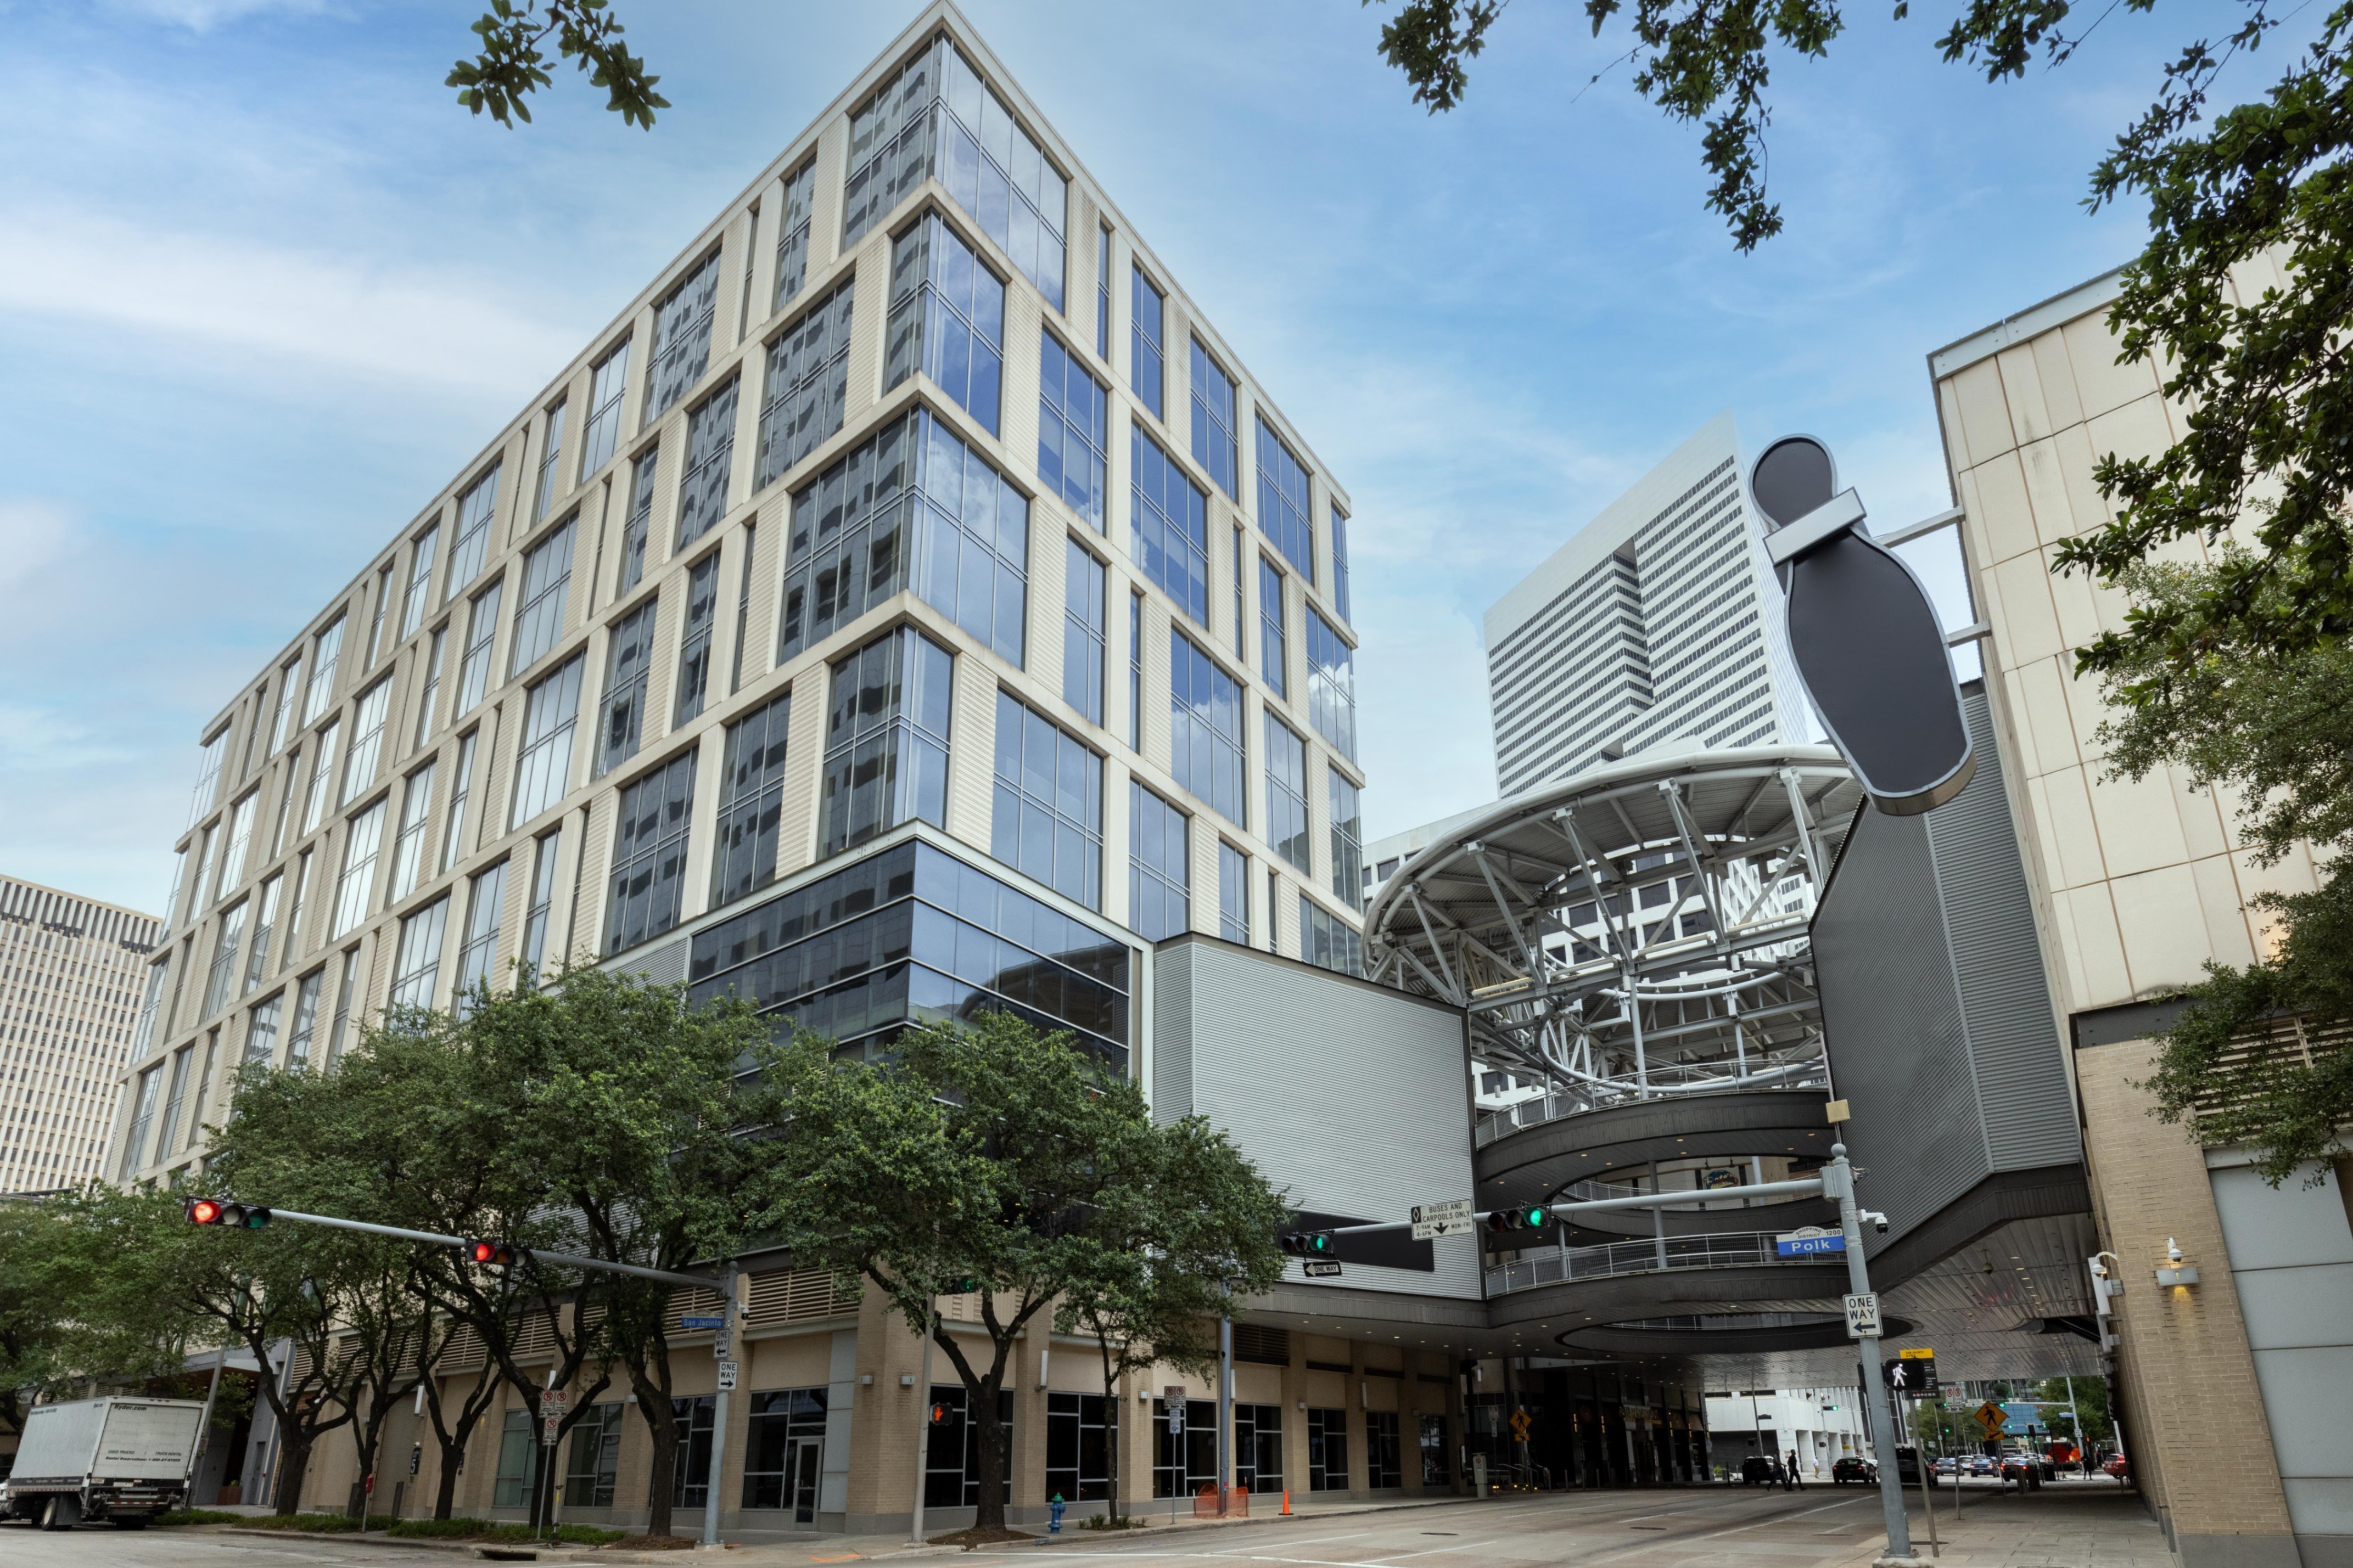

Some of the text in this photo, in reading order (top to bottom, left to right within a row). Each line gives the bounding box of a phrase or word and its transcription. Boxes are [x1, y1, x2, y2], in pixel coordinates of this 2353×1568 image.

[1422, 1210, 1470, 1222] CARPOOLS ONLY
[1791, 1239, 1830, 1252] Polk
[1848, 1297, 1873, 1308] ONE
[1849, 1308, 1875, 1320] WAY
[411, 1459, 416, 1474] 5
